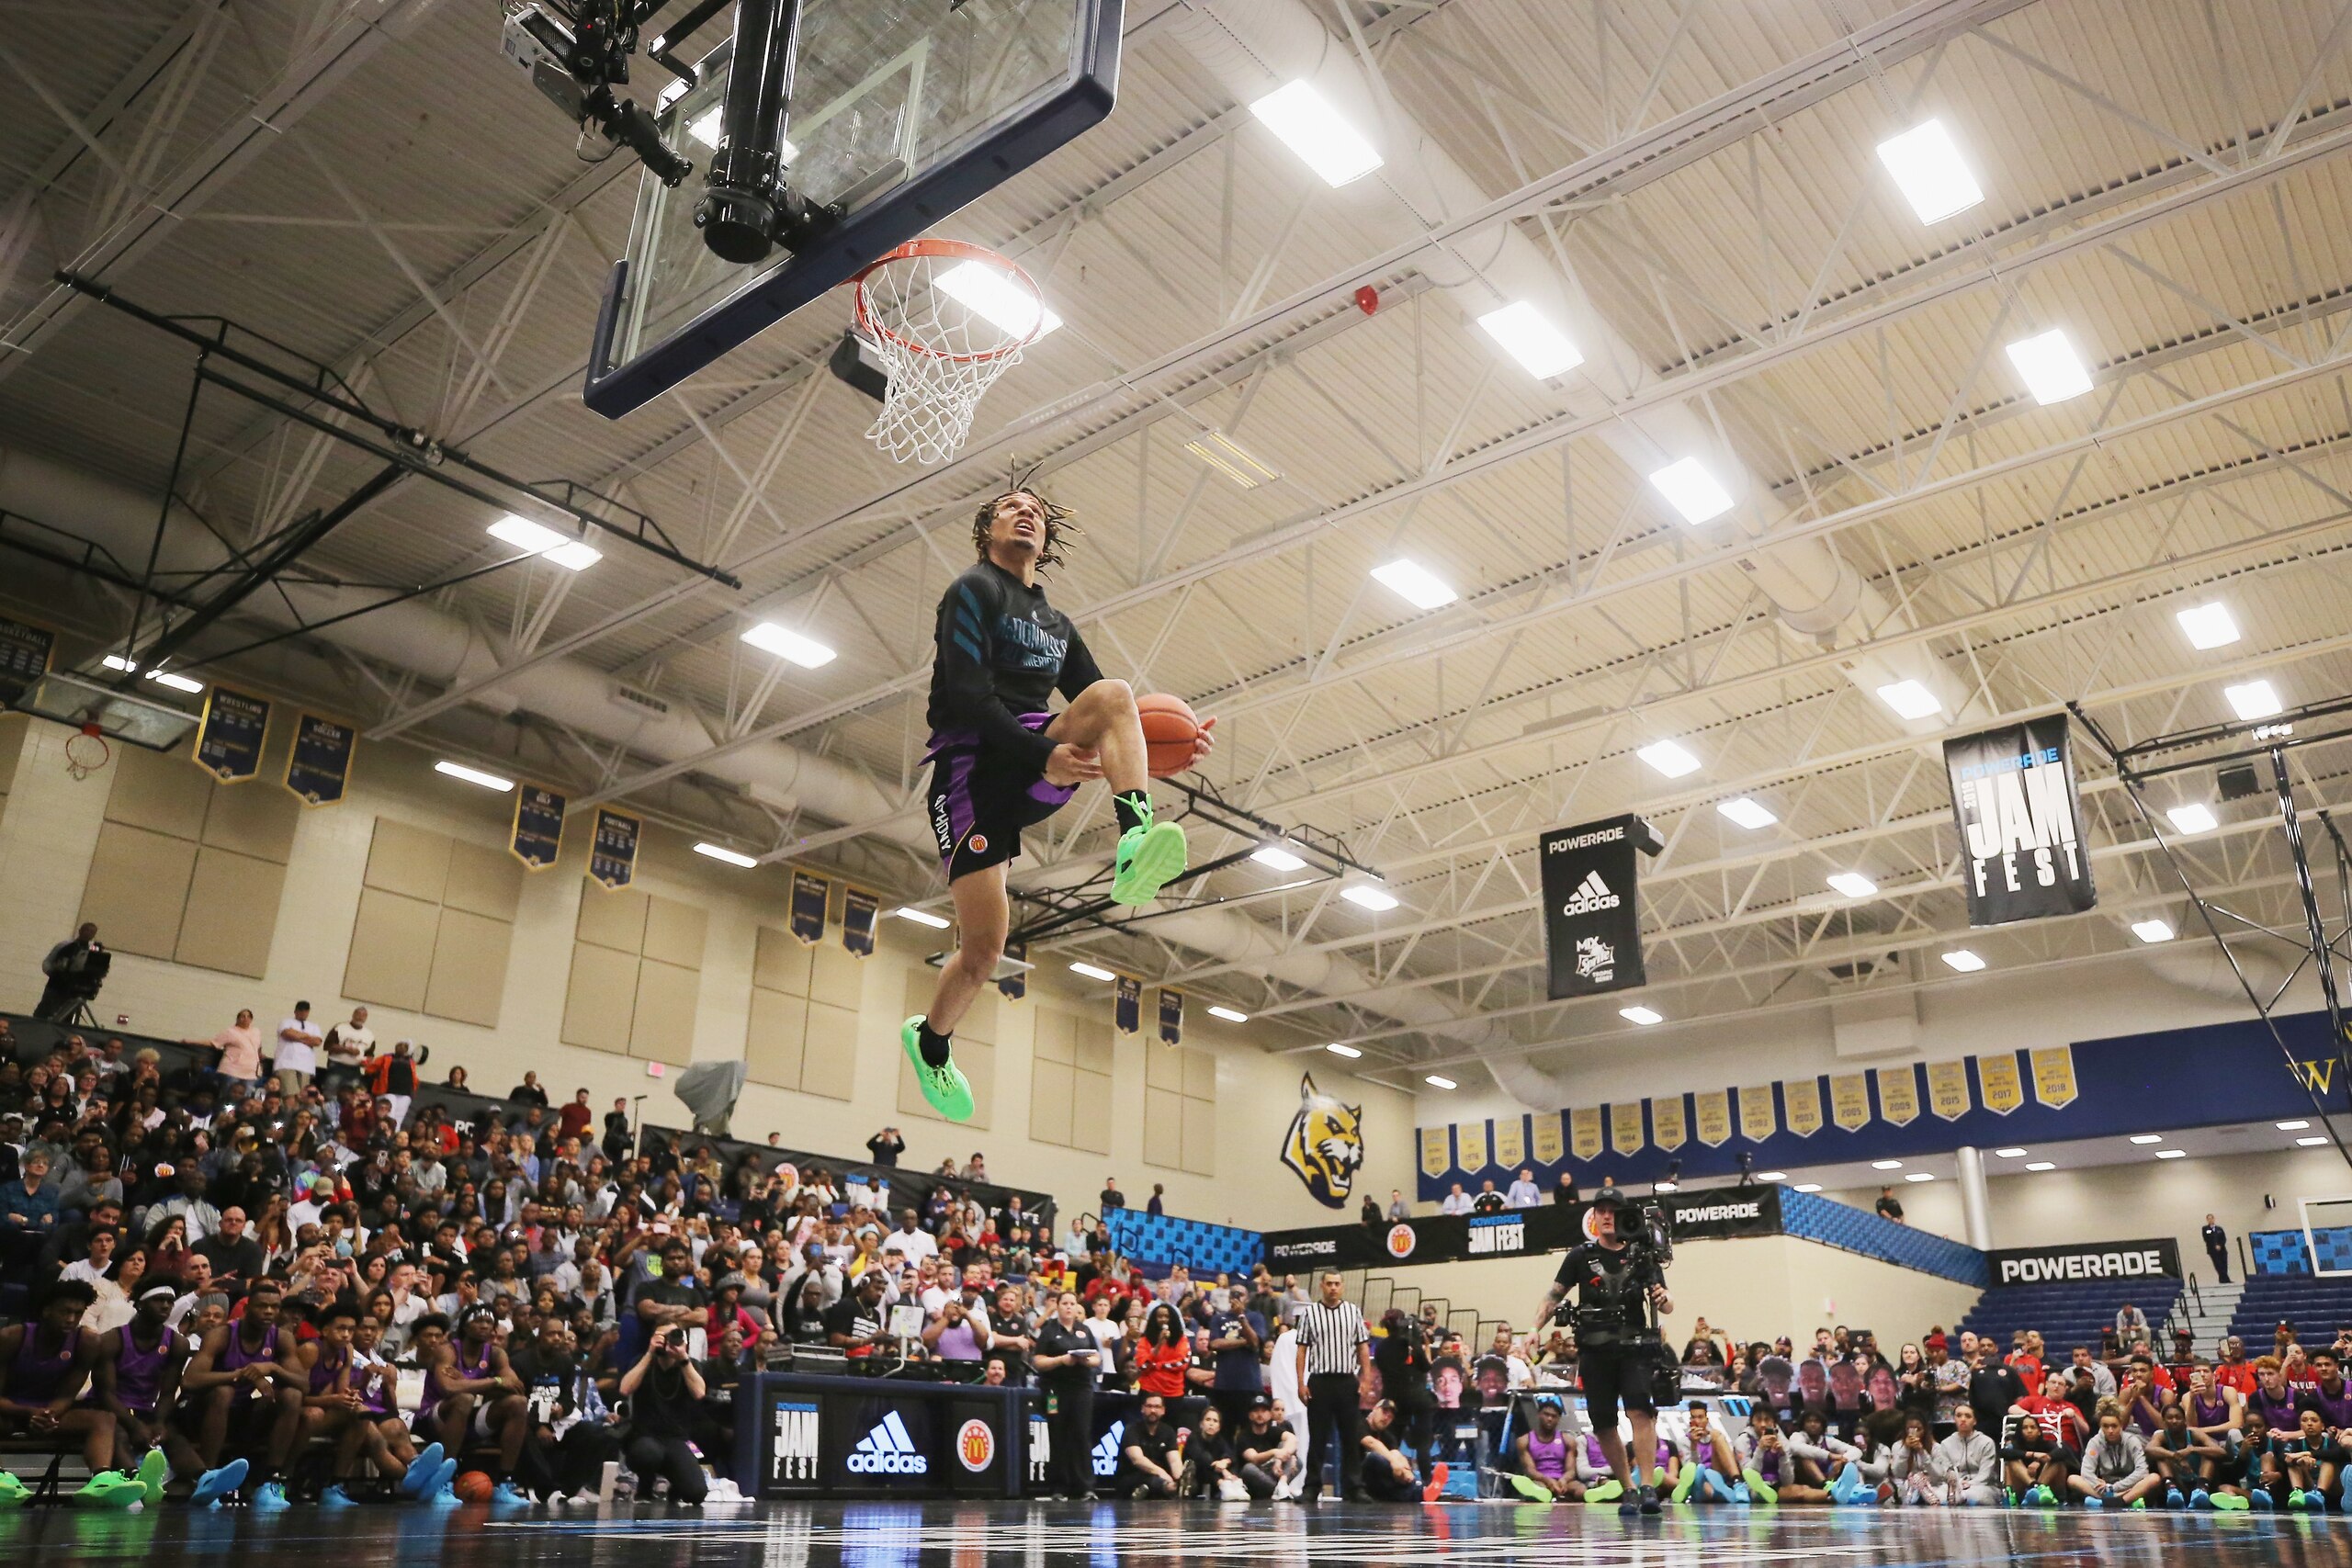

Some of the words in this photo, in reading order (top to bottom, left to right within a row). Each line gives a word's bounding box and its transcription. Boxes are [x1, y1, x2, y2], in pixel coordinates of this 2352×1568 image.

[1961, 747, 2059, 780] POWERADE
[1962, 781, 1975, 809] 2019
[1966, 761, 2075, 859] JAM
[1549, 827, 1624, 854] POWERADE
[1973, 840, 2080, 897] FEST
[1564, 894, 1621, 917] adidas
[1580, 950, 1611, 975] Sprite
[2046, 1083, 2066, 1094] 2018
[2285, 1058, 2337, 1096] W
[1889, 1101, 1911, 1111] 2009
[1940, 1096, 1960, 1106] 2015
[1993, 1089, 2012, 1100] 2017
[1675, 1202, 1759, 1224] POWERADE
[1468, 1225, 1496, 1254] JAM
[1496, 1223, 1525, 1251] FEST
[2001, 1250, 2164, 1283] POWERADE
[774, 1411, 819, 1459] JAM
[1029, 1422, 1050, 1463] JA
[773, 1456, 818, 1480] FEST
[846, 1450, 928, 1473] adidas
[1029, 1462, 1046, 1482] FE
